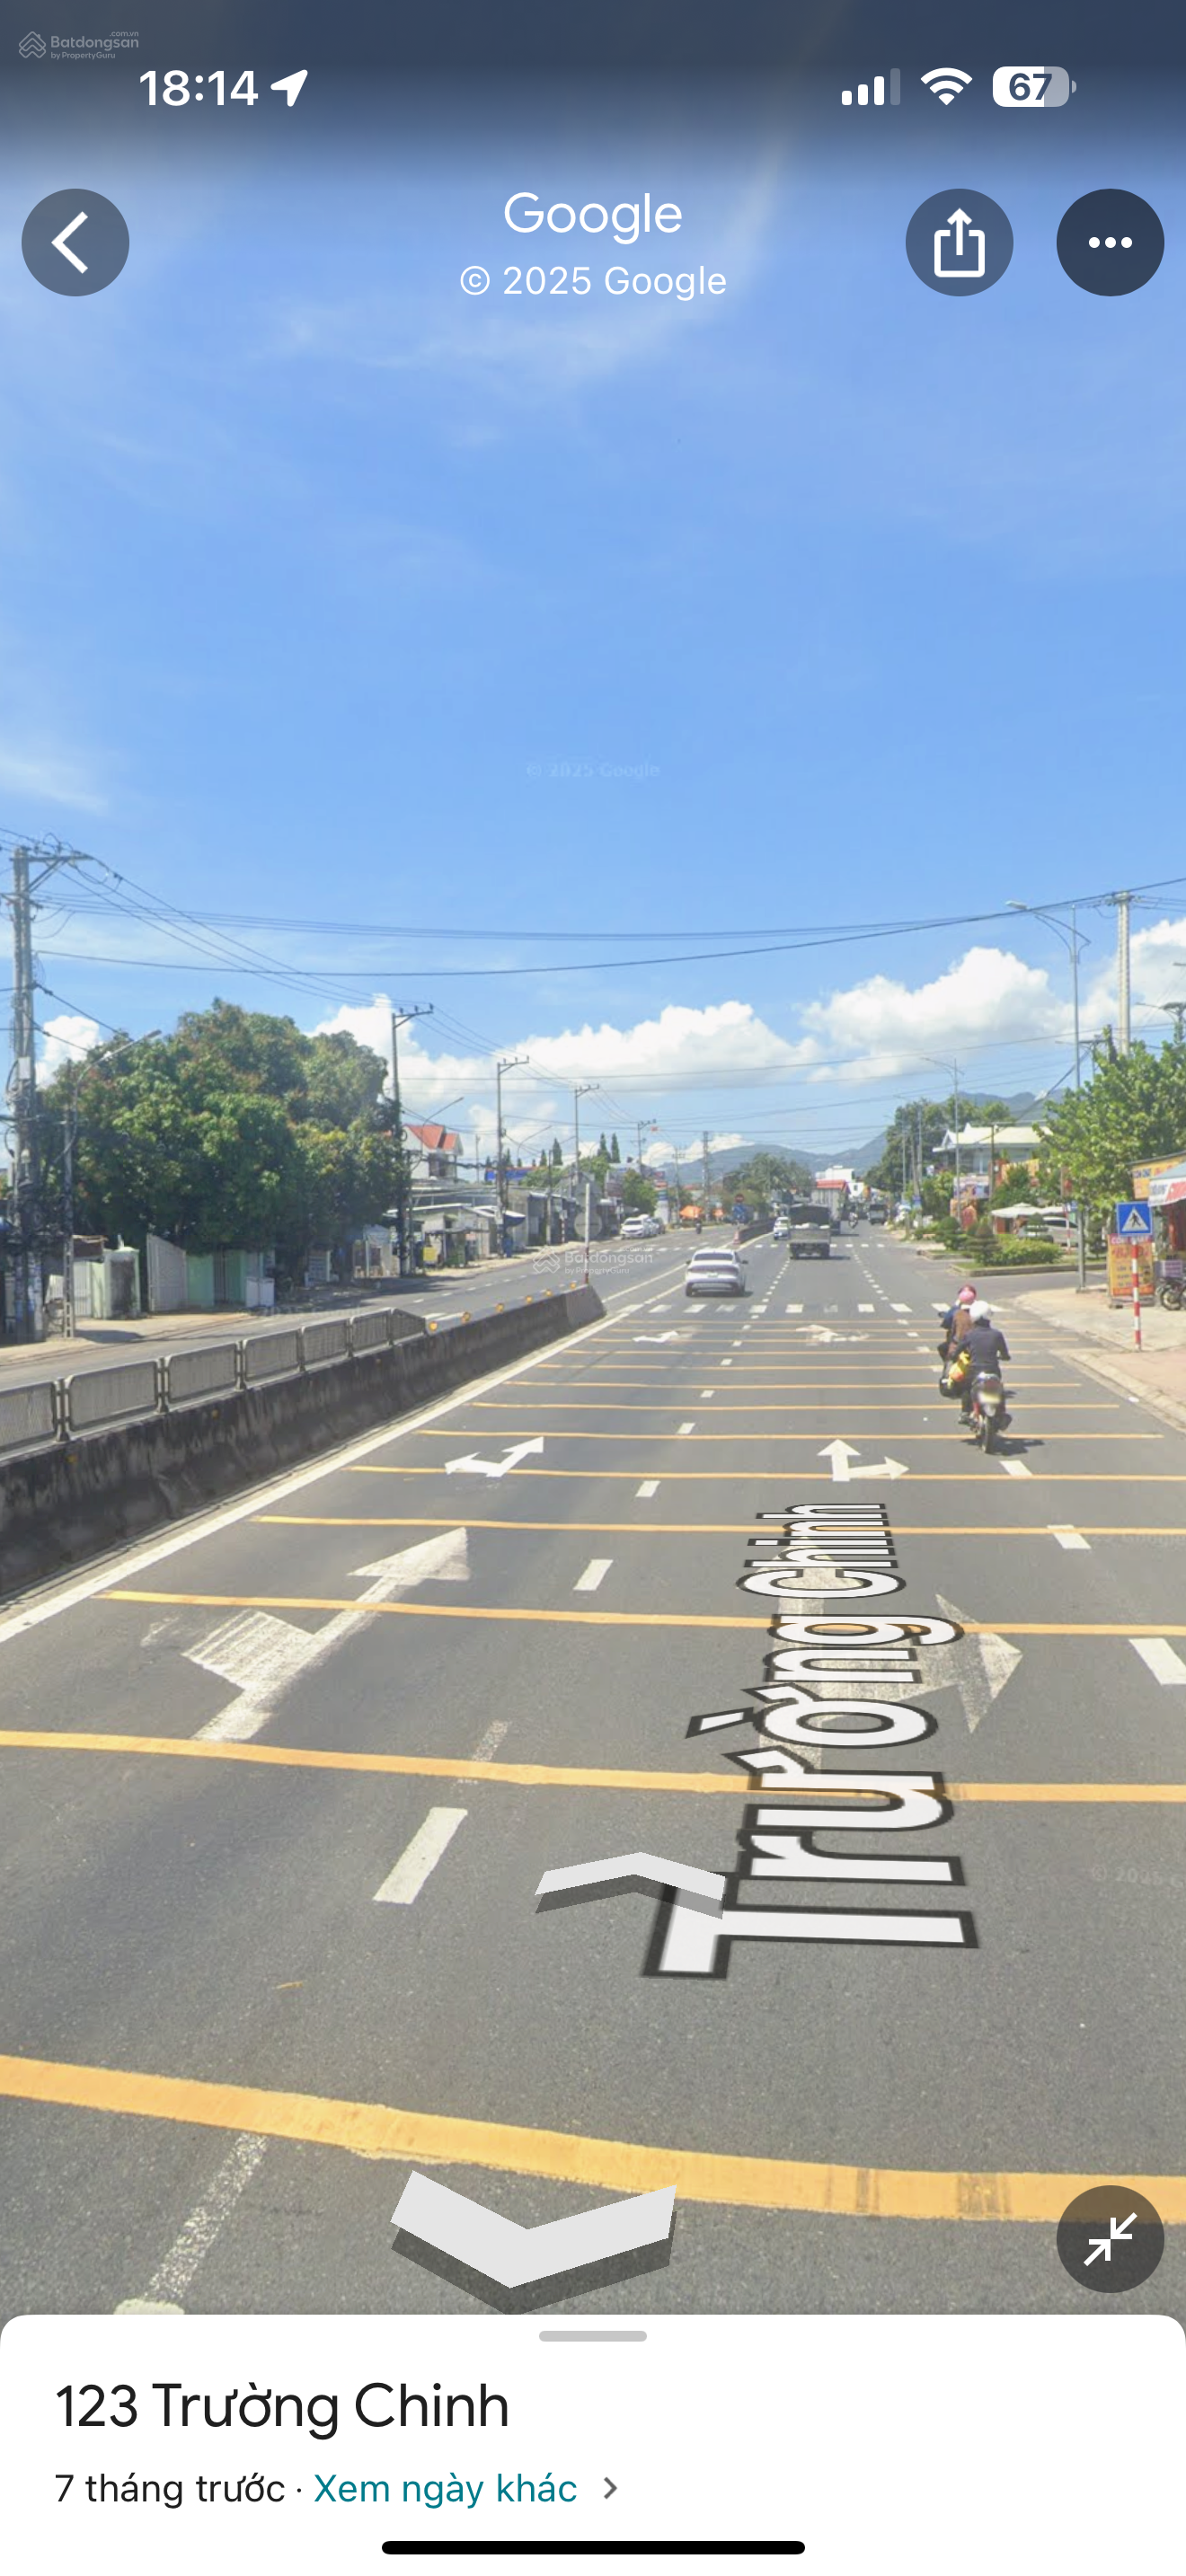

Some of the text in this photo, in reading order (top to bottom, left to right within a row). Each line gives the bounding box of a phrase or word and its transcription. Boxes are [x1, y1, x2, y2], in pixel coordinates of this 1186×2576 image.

[140, 69, 259, 107] 18:14
[1008, 73, 1053, 101] 67
[504, 191, 683, 245] Google
[503, 266, 591, 296] 2025
[605, 266, 727, 302] Google
[56, 2380, 508, 2440] 123 Trường Chinh
[55, 2470, 578, 2510] 7 tháng trước Xem ngày khác
